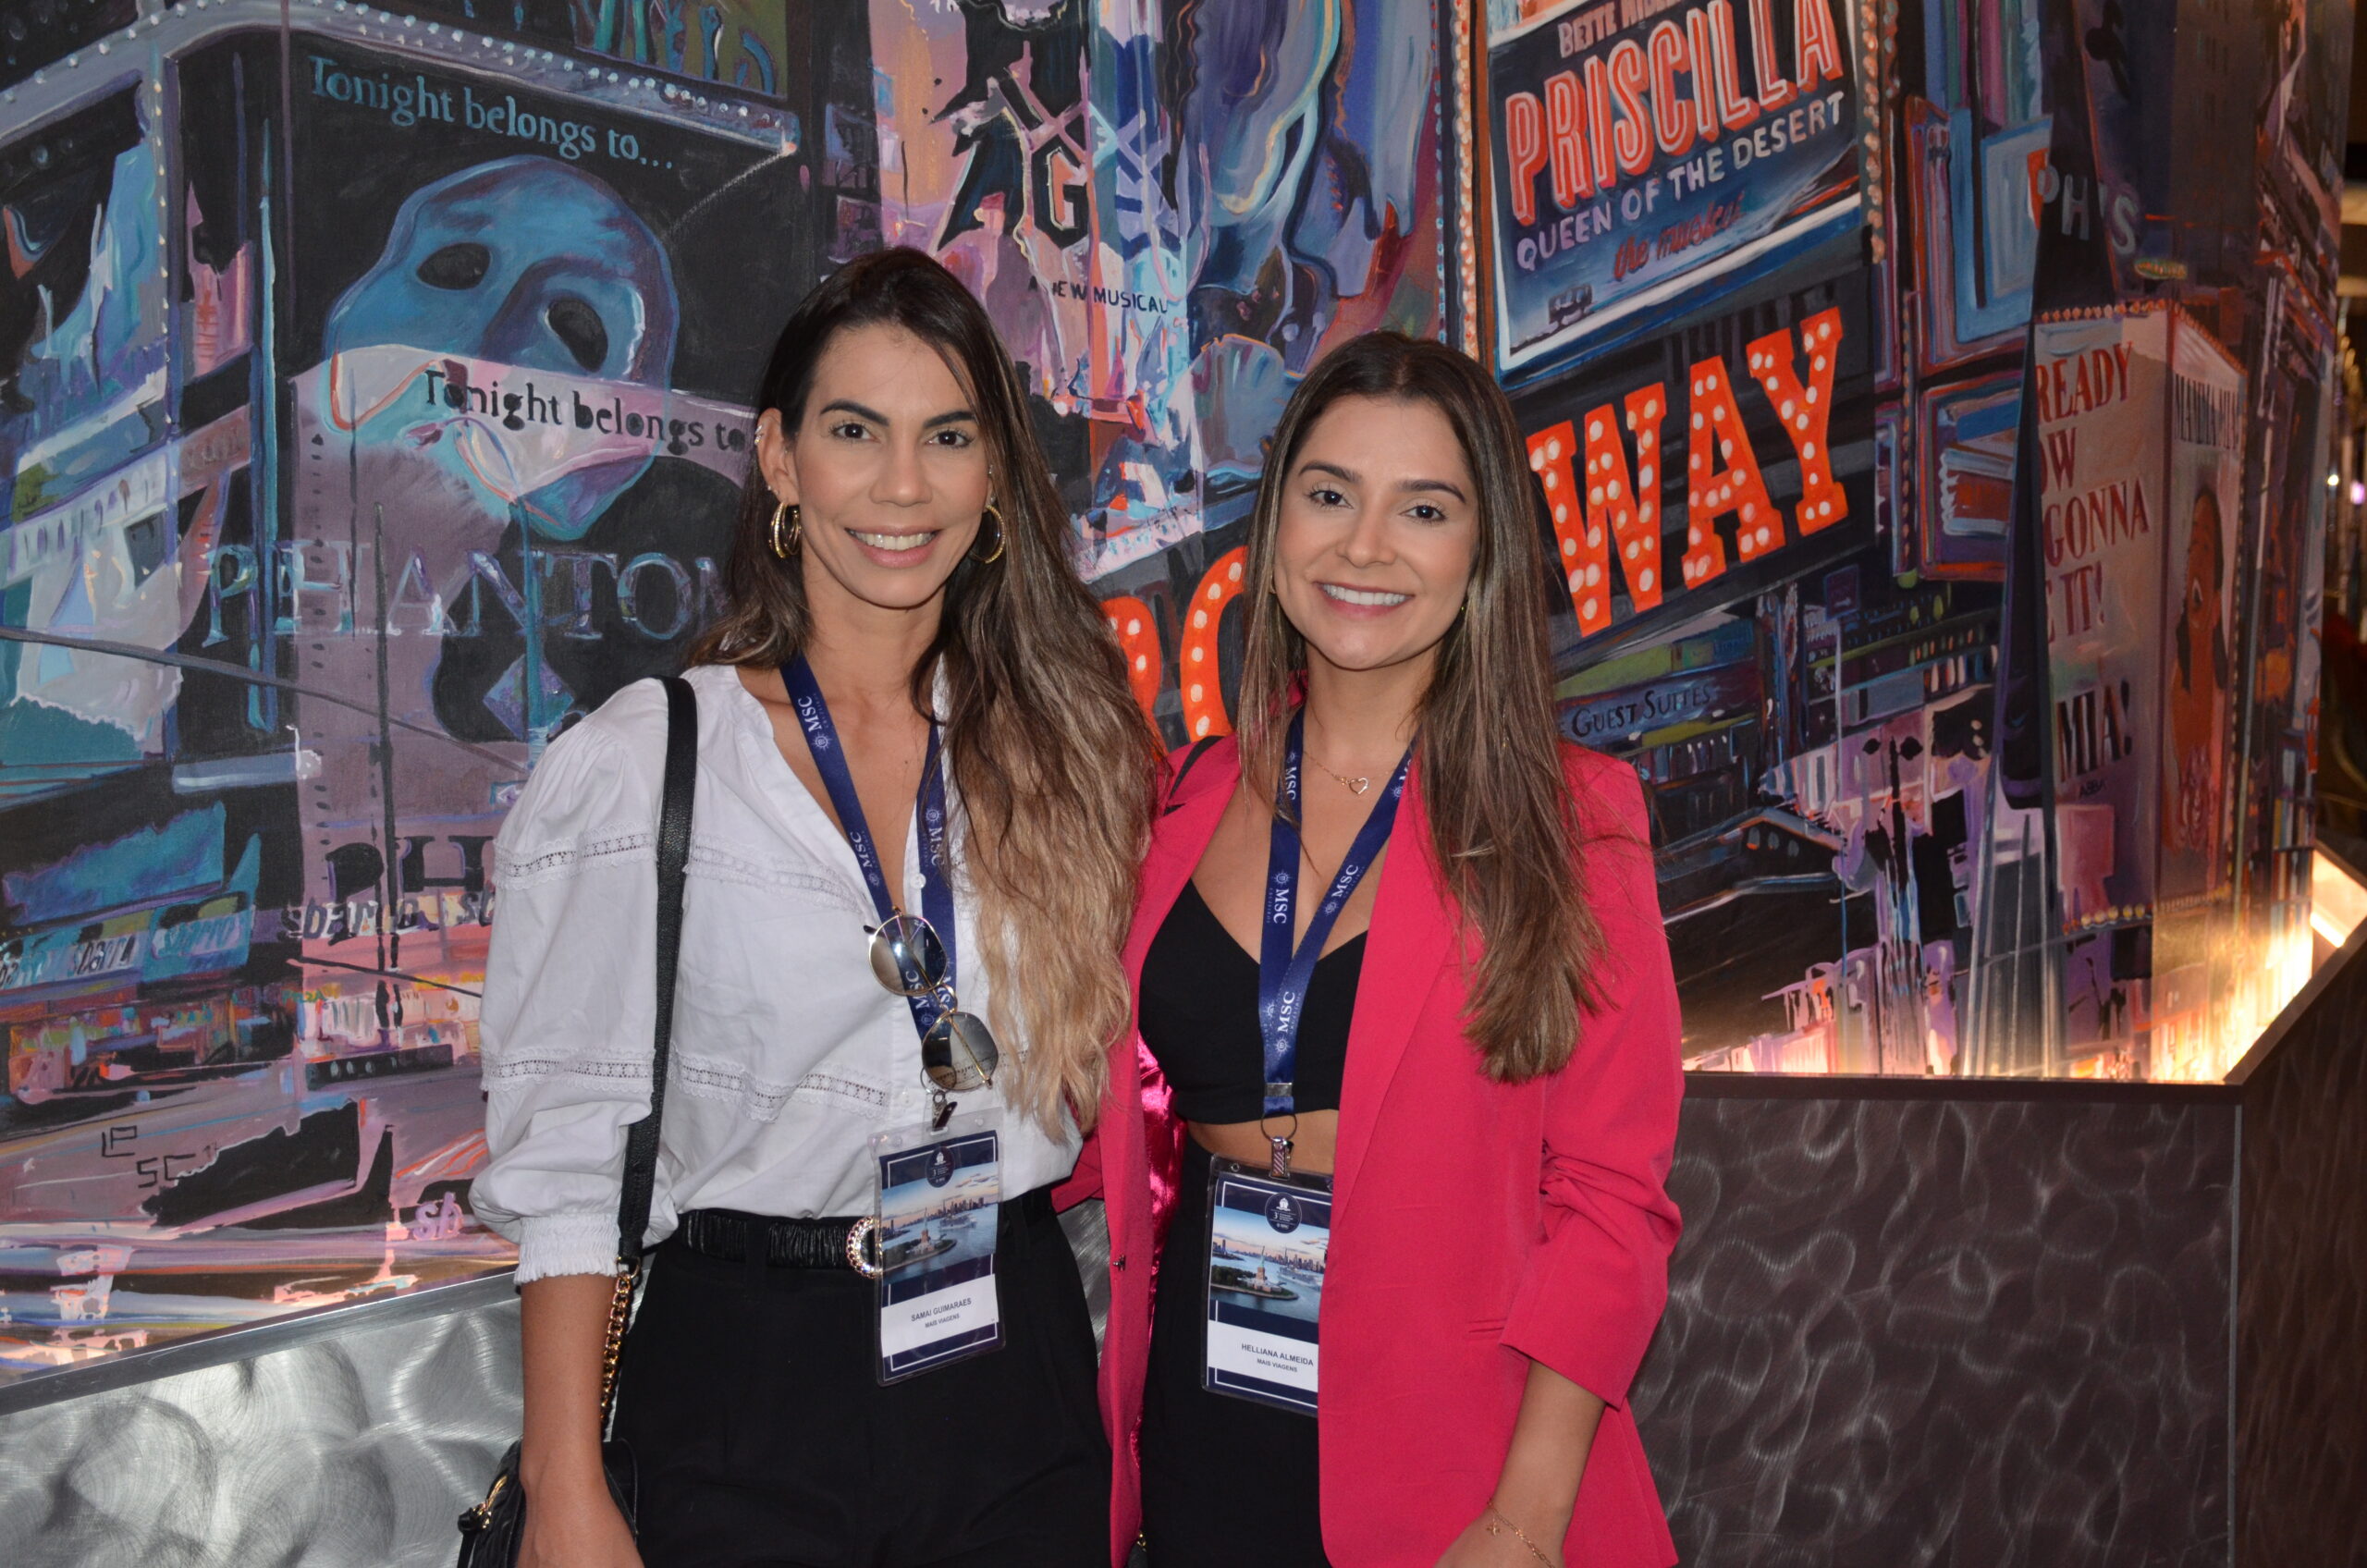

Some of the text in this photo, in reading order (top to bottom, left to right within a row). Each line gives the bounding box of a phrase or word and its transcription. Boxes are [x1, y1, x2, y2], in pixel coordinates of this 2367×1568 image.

[307, 55, 456, 127] Tonight
[463, 87, 598, 160] belongs
[1504, 0, 1844, 227] PRISCILLA
[1516, 91, 1845, 272] QUEEN OF THE DESERT
[1613, 236, 1650, 280] the
[1093, 286, 1168, 314] MUSICAL
[424, 368, 563, 432] Tonight
[572, 389, 705, 457] belongs
[2043, 476, 2150, 568] GONNA
[798, 695, 822, 733] MSC
[1572, 704, 1637, 738] GUEST
[1642, 684, 1711, 719] SUITES
[1285, 766, 1296, 801] MSC
[850, 831, 873, 867] MSC
[1331, 864, 1359, 897] MSC
[1273, 888, 1290, 924] MSC
[1277, 991, 1295, 1033] MSC
[1241, 1342, 1314, 1366] HELLIANA ALMEIDA
[1272, 1362, 1298, 1373] VIAGENS
